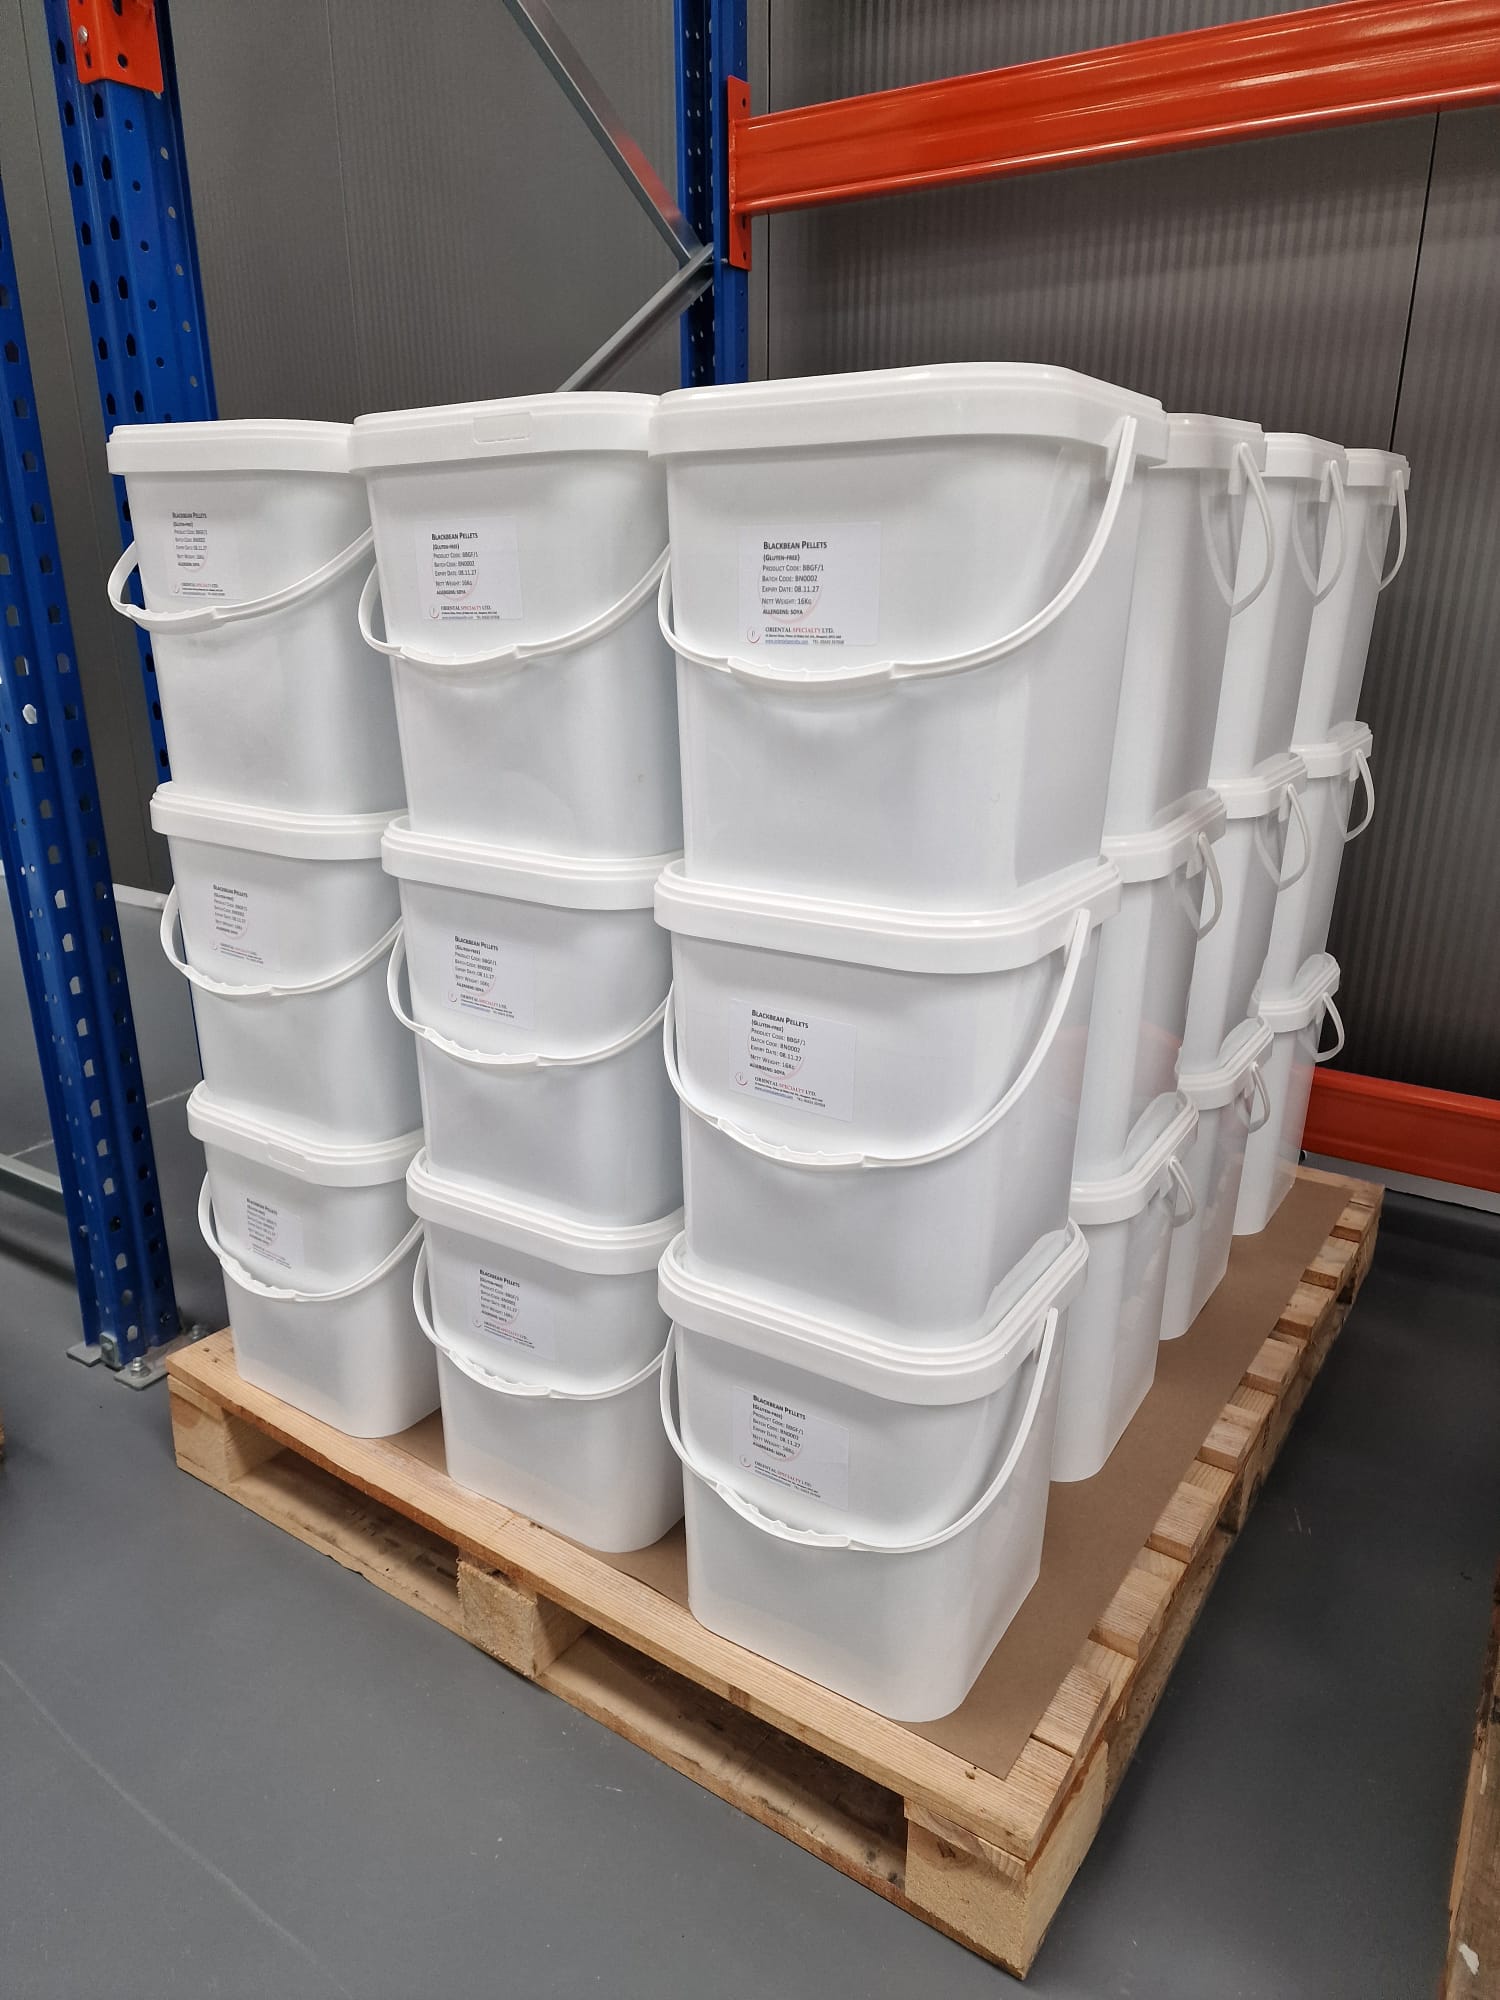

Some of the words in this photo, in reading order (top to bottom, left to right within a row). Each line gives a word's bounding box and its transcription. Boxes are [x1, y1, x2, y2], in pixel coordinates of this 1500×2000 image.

[763, 541, 800, 550] BLACKBEAN
[801, 540, 828, 549] PELLETS
[762, 564, 785, 572] PRODUCT
[752, 1009, 785, 1023] BLACKBEAN
[786, 1017, 809, 1029] PELLETS
[753, 1394, 783, 1411] BLACKBEAN
[784, 1406, 806, 1420] PELLETS
